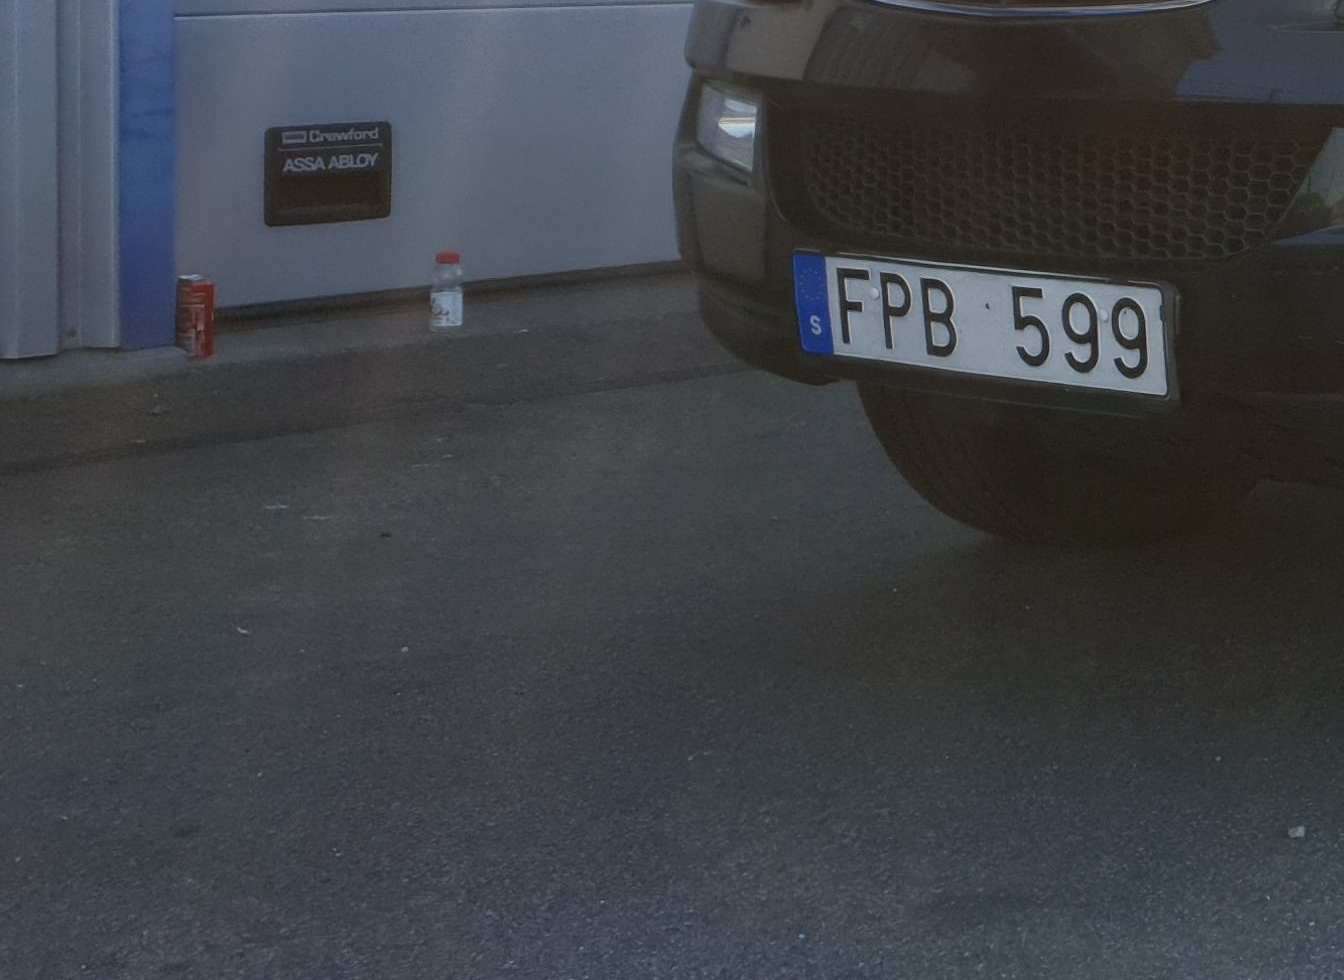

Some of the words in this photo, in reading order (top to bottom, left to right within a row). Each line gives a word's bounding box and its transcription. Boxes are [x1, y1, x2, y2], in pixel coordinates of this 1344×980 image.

[309, 127, 379, 143] Crawford
[283, 156, 326, 172] ASSA
[327, 153, 379, 169] ABLOY
[810, 314, 823, 335] S
[836, 267, 958, 357] FPB
[1012, 285, 1149, 379] 599
